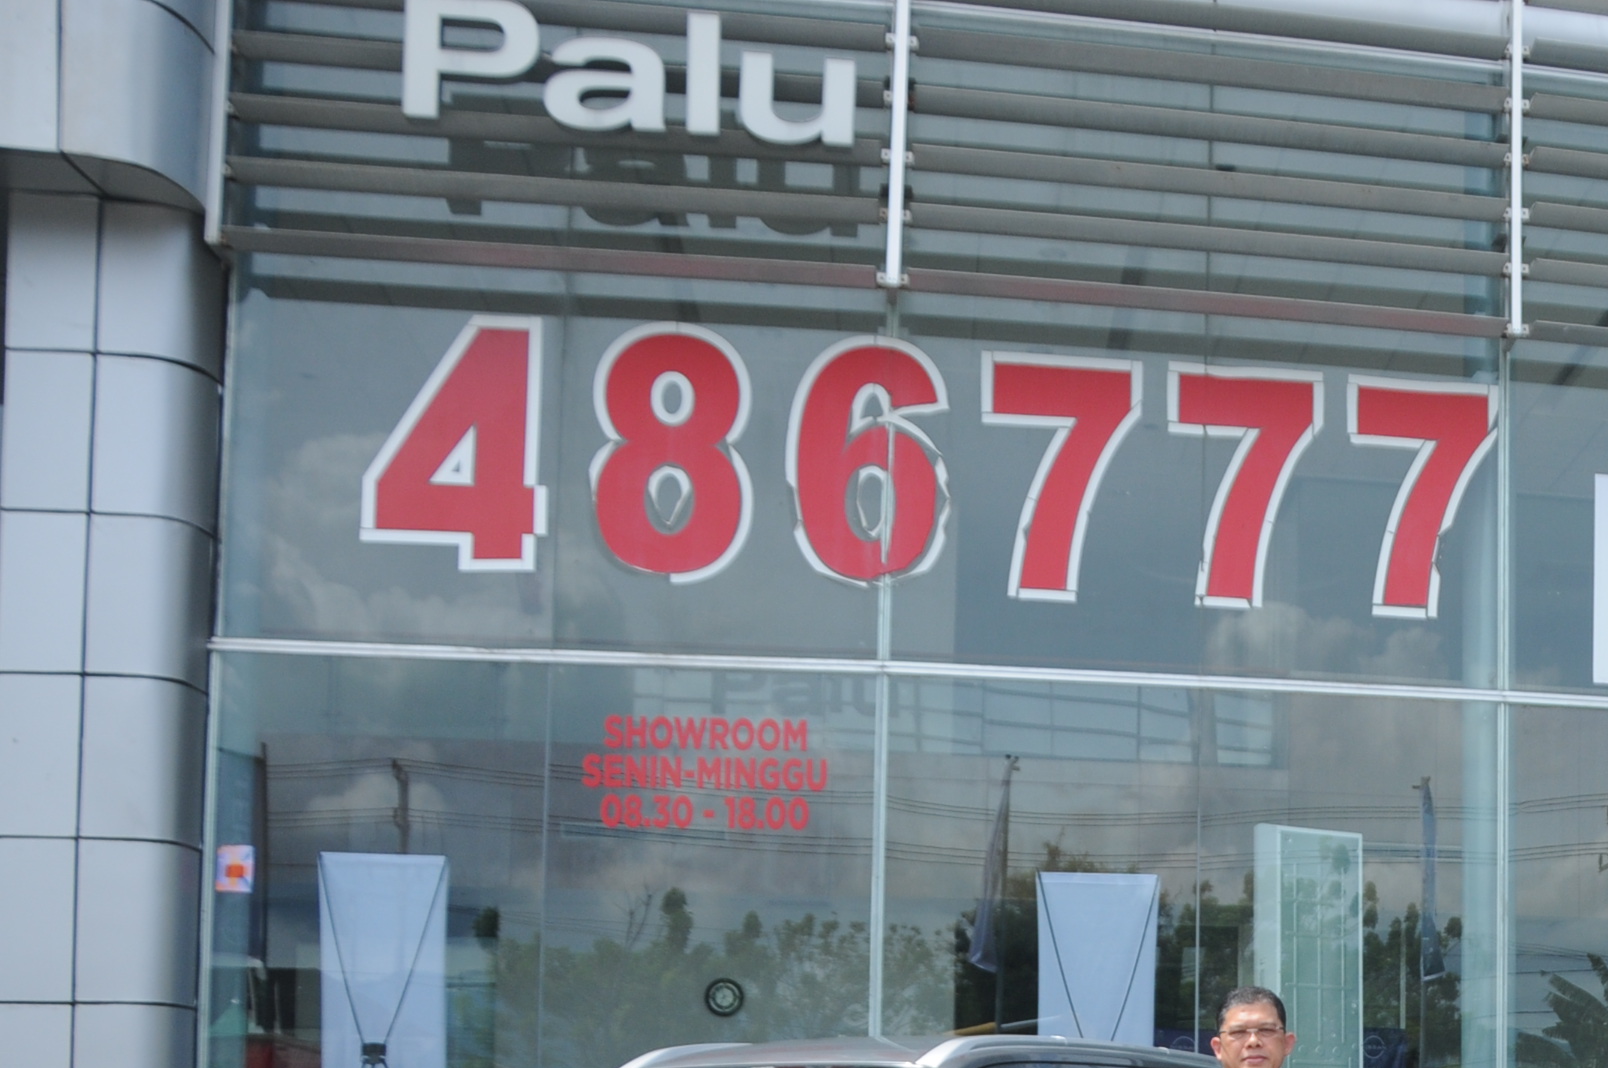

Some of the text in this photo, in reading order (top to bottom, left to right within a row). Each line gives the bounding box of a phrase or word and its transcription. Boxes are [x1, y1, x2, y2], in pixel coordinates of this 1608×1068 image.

[401, 0, 856, 147] Palu
[360, 314, 1498, 620] 486777
[603, 714, 808, 752] SHOWROOM
[582, 753, 828, 792] SENIN-MINGGU
[600, 793, 694, 830] 08.30
[725, 796, 810, 831] 18.00
